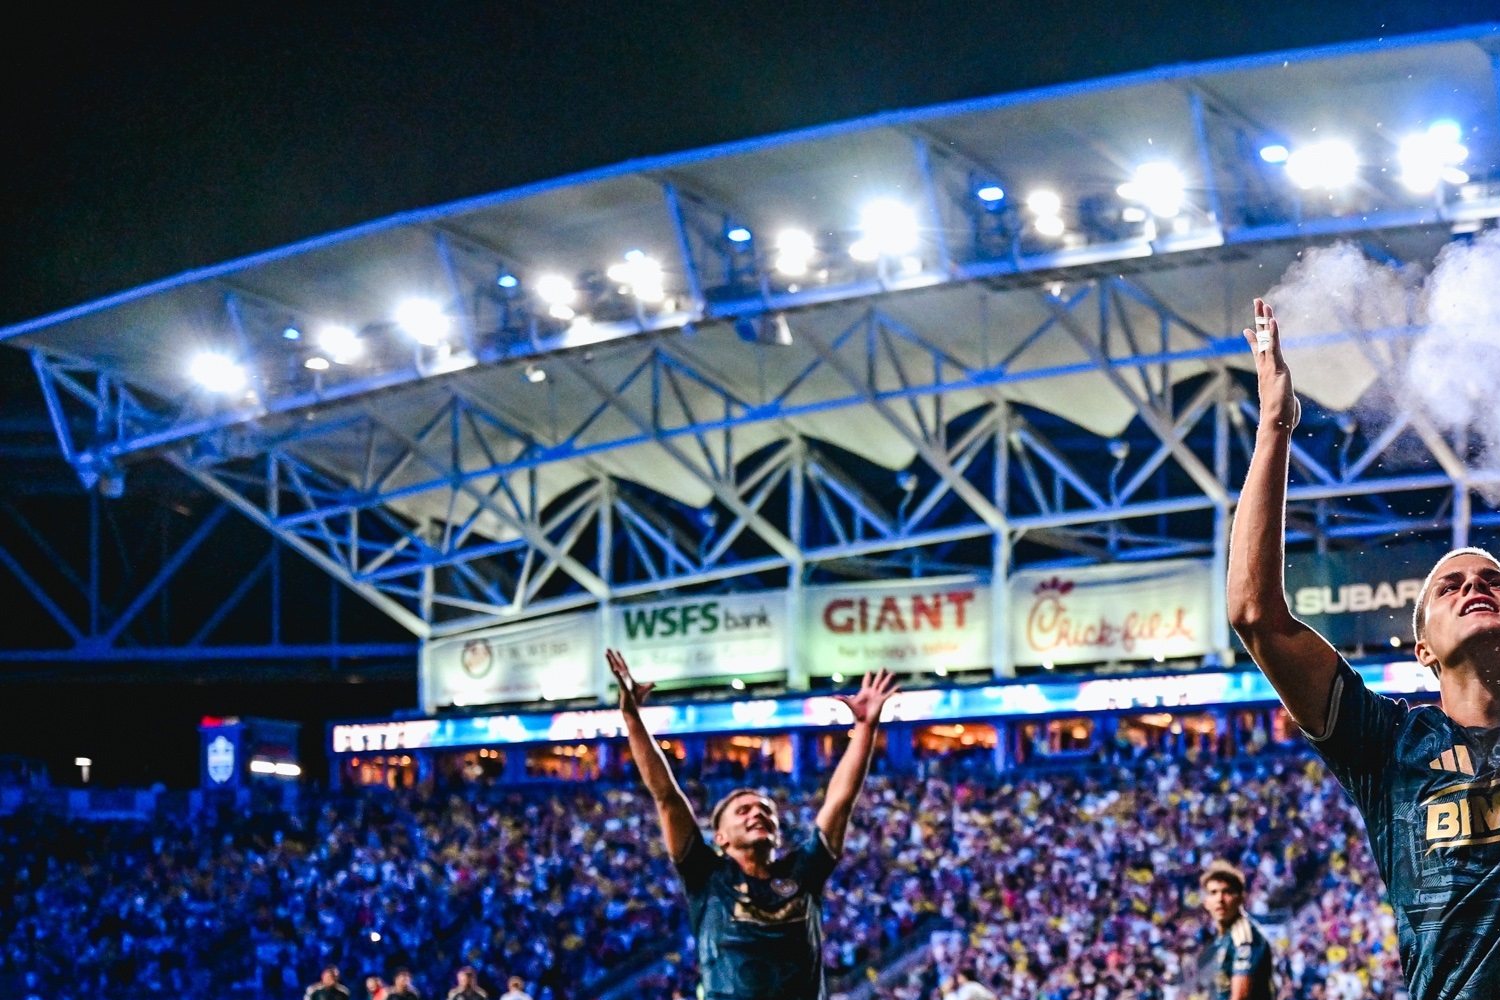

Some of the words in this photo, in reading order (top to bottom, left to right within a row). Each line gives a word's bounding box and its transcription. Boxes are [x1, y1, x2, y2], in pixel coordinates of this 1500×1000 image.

[823, 590, 975, 634] GIANT
[1295, 579, 1422, 615] SUBAR
[624, 602, 719, 640] WSFS
[724, 604, 771, 631] bank
